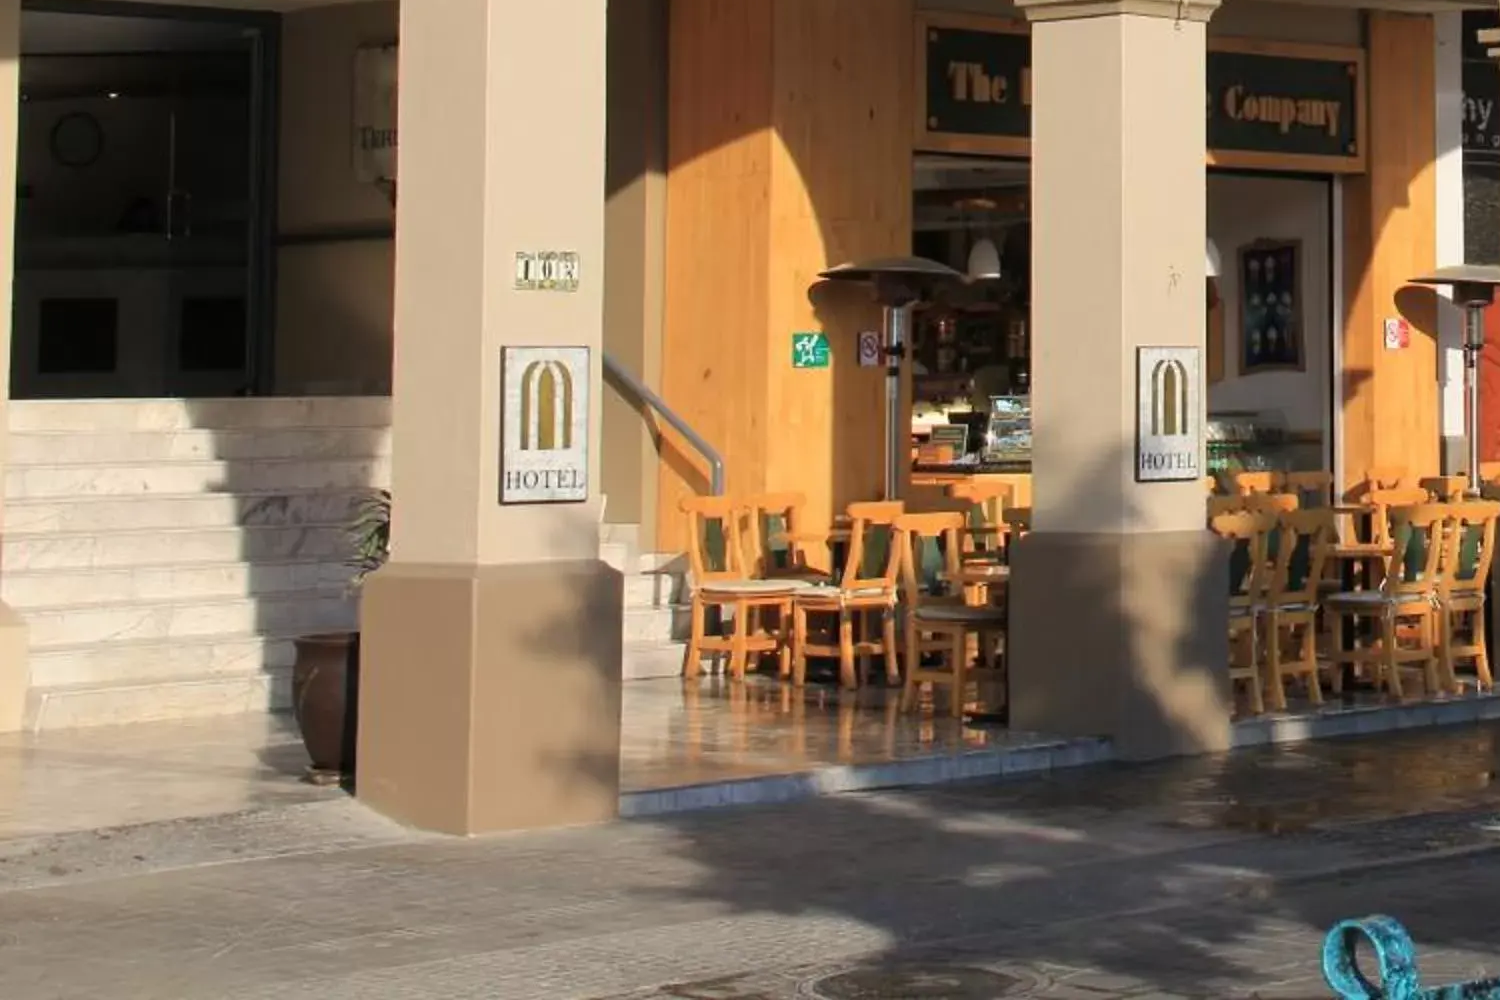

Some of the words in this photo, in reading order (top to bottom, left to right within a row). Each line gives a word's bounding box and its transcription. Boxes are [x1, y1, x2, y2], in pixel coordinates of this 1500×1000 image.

[947, 60, 1008, 104] The
[1224, 84, 1341, 137] Company
[1141, 452, 1197, 470] HOTEL
[506, 468, 585, 490] HOTEL
